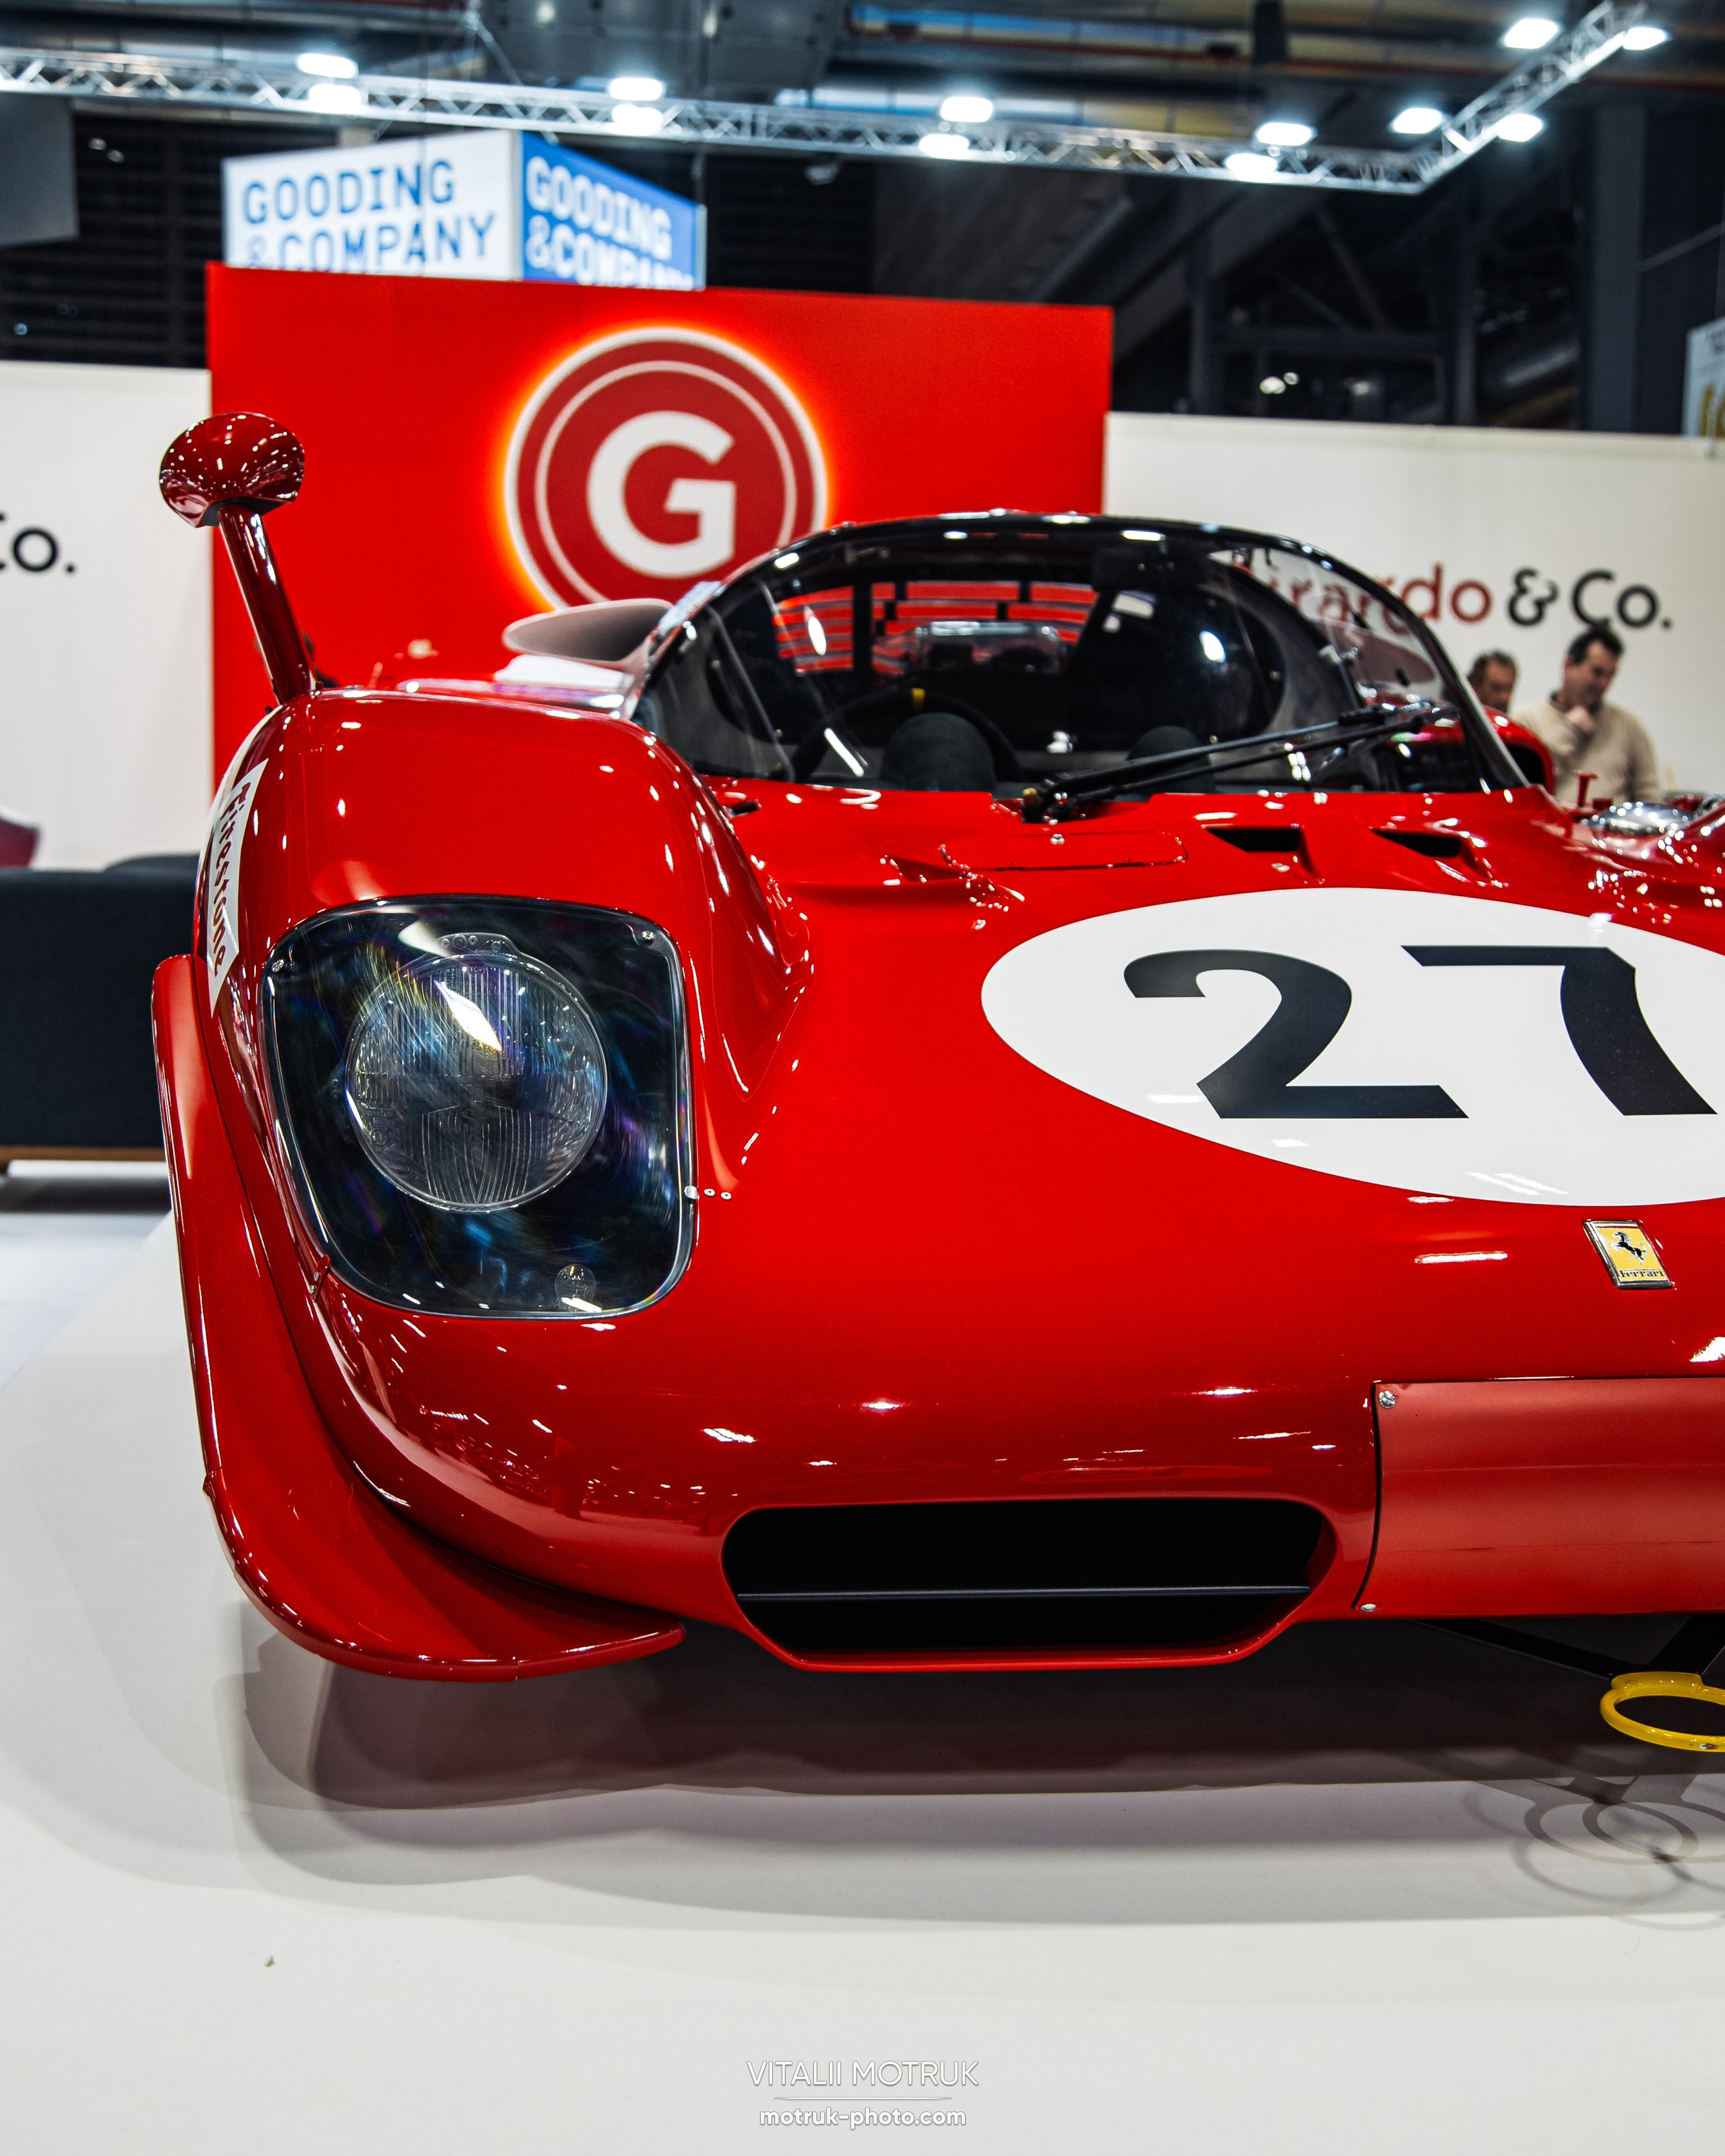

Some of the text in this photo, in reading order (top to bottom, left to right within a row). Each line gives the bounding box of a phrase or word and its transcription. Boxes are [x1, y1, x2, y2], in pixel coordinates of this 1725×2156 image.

[243, 159, 453, 224] GOODING
[526, 156, 672, 261] GOODING
[587, 410, 736, 579] G
[0, 509, 77, 575] o.
[1230, 563, 1493, 636] irardo
[1571, 569, 1673, 630] Co.
[212, 782, 251, 977] Firestone
[1123, 945, 1718, 1118] 27
[1619, 1269, 1664, 1277] Ferrari
